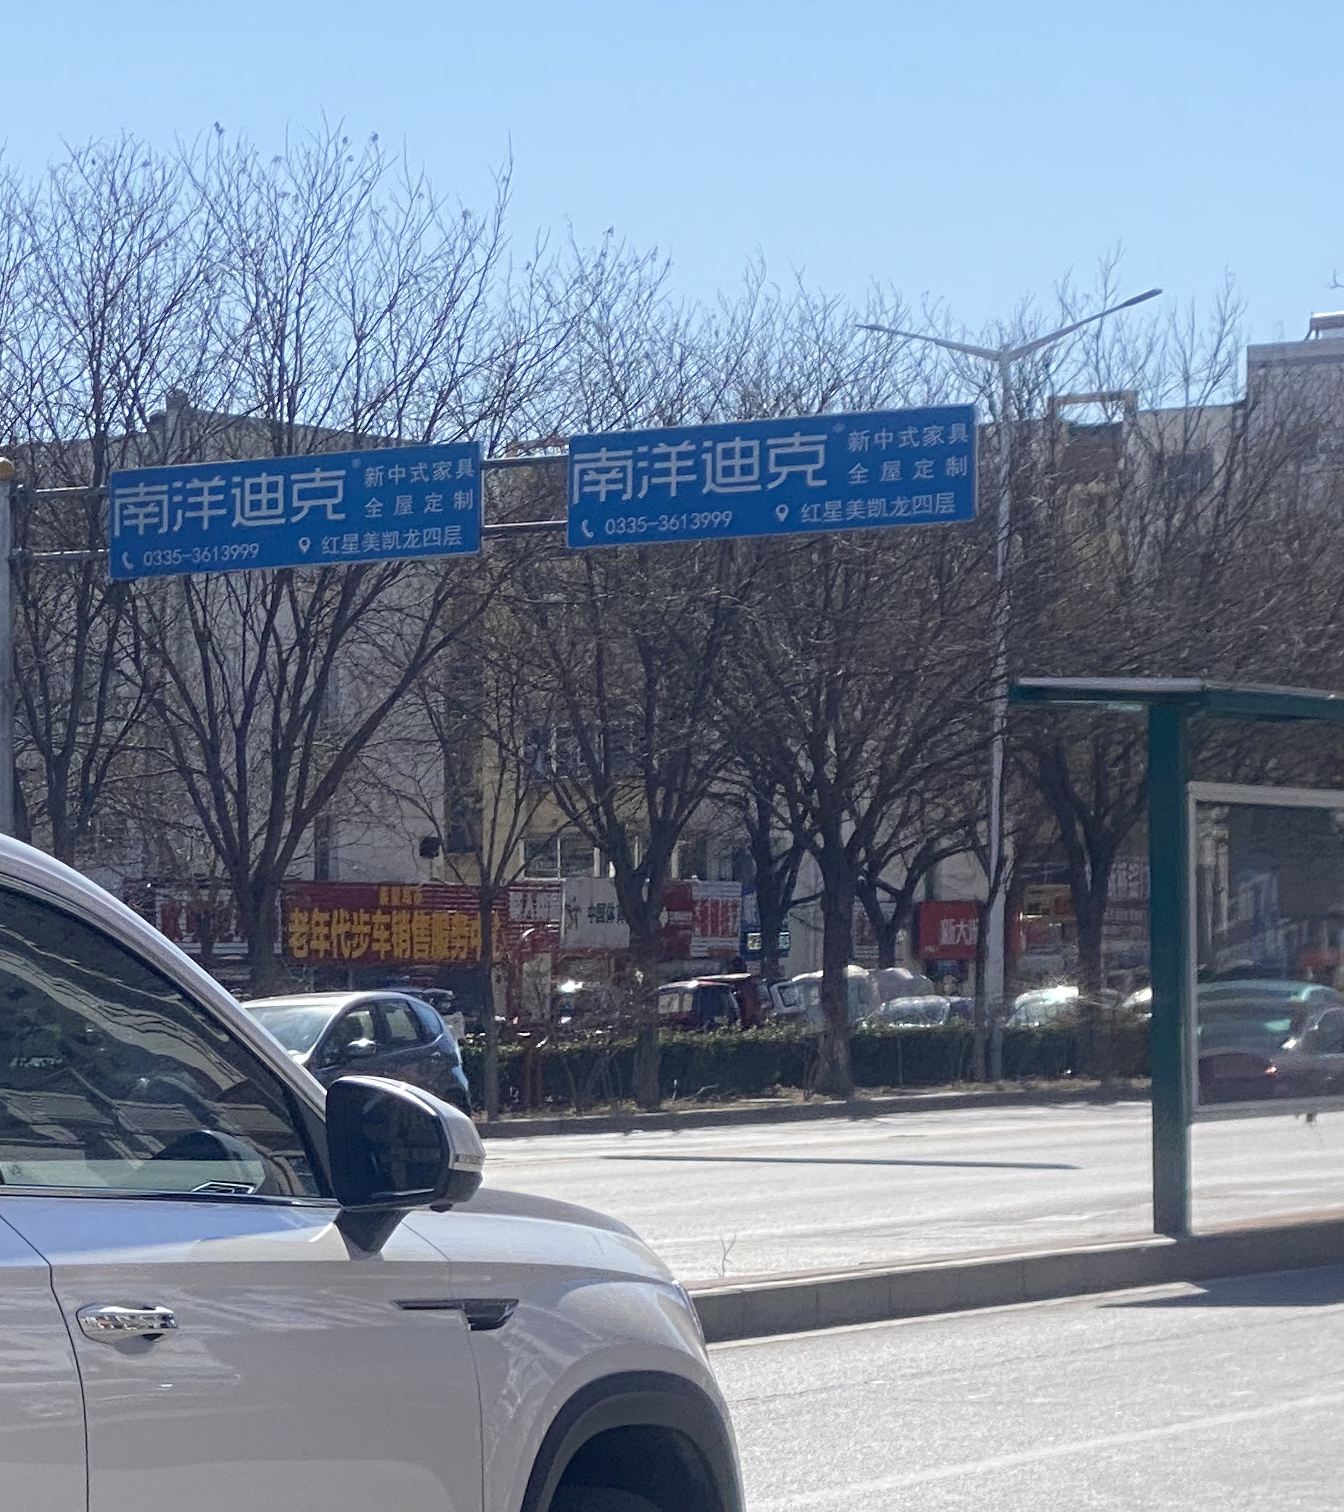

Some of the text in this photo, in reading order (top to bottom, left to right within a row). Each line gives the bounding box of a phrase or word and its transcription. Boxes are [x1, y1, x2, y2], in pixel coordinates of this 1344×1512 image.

[847, 422, 970, 453] 新中式家具
[363, 457, 476, 489] 新中式家具
[572, 432, 829, 506] 南洋迪克
[847, 456, 968, 486] 全屋定制
[113, 467, 348, 538] 南洋迪克
[364, 488, 474, 519] 全屋定制
[800, 491, 957, 524] 红星美凯龙四层
[604, 510, 733, 535] 0335-3613999
[143, 542, 261, 567] 0335-3613999
[321, 525, 463, 556] 红星美凯龙四层
